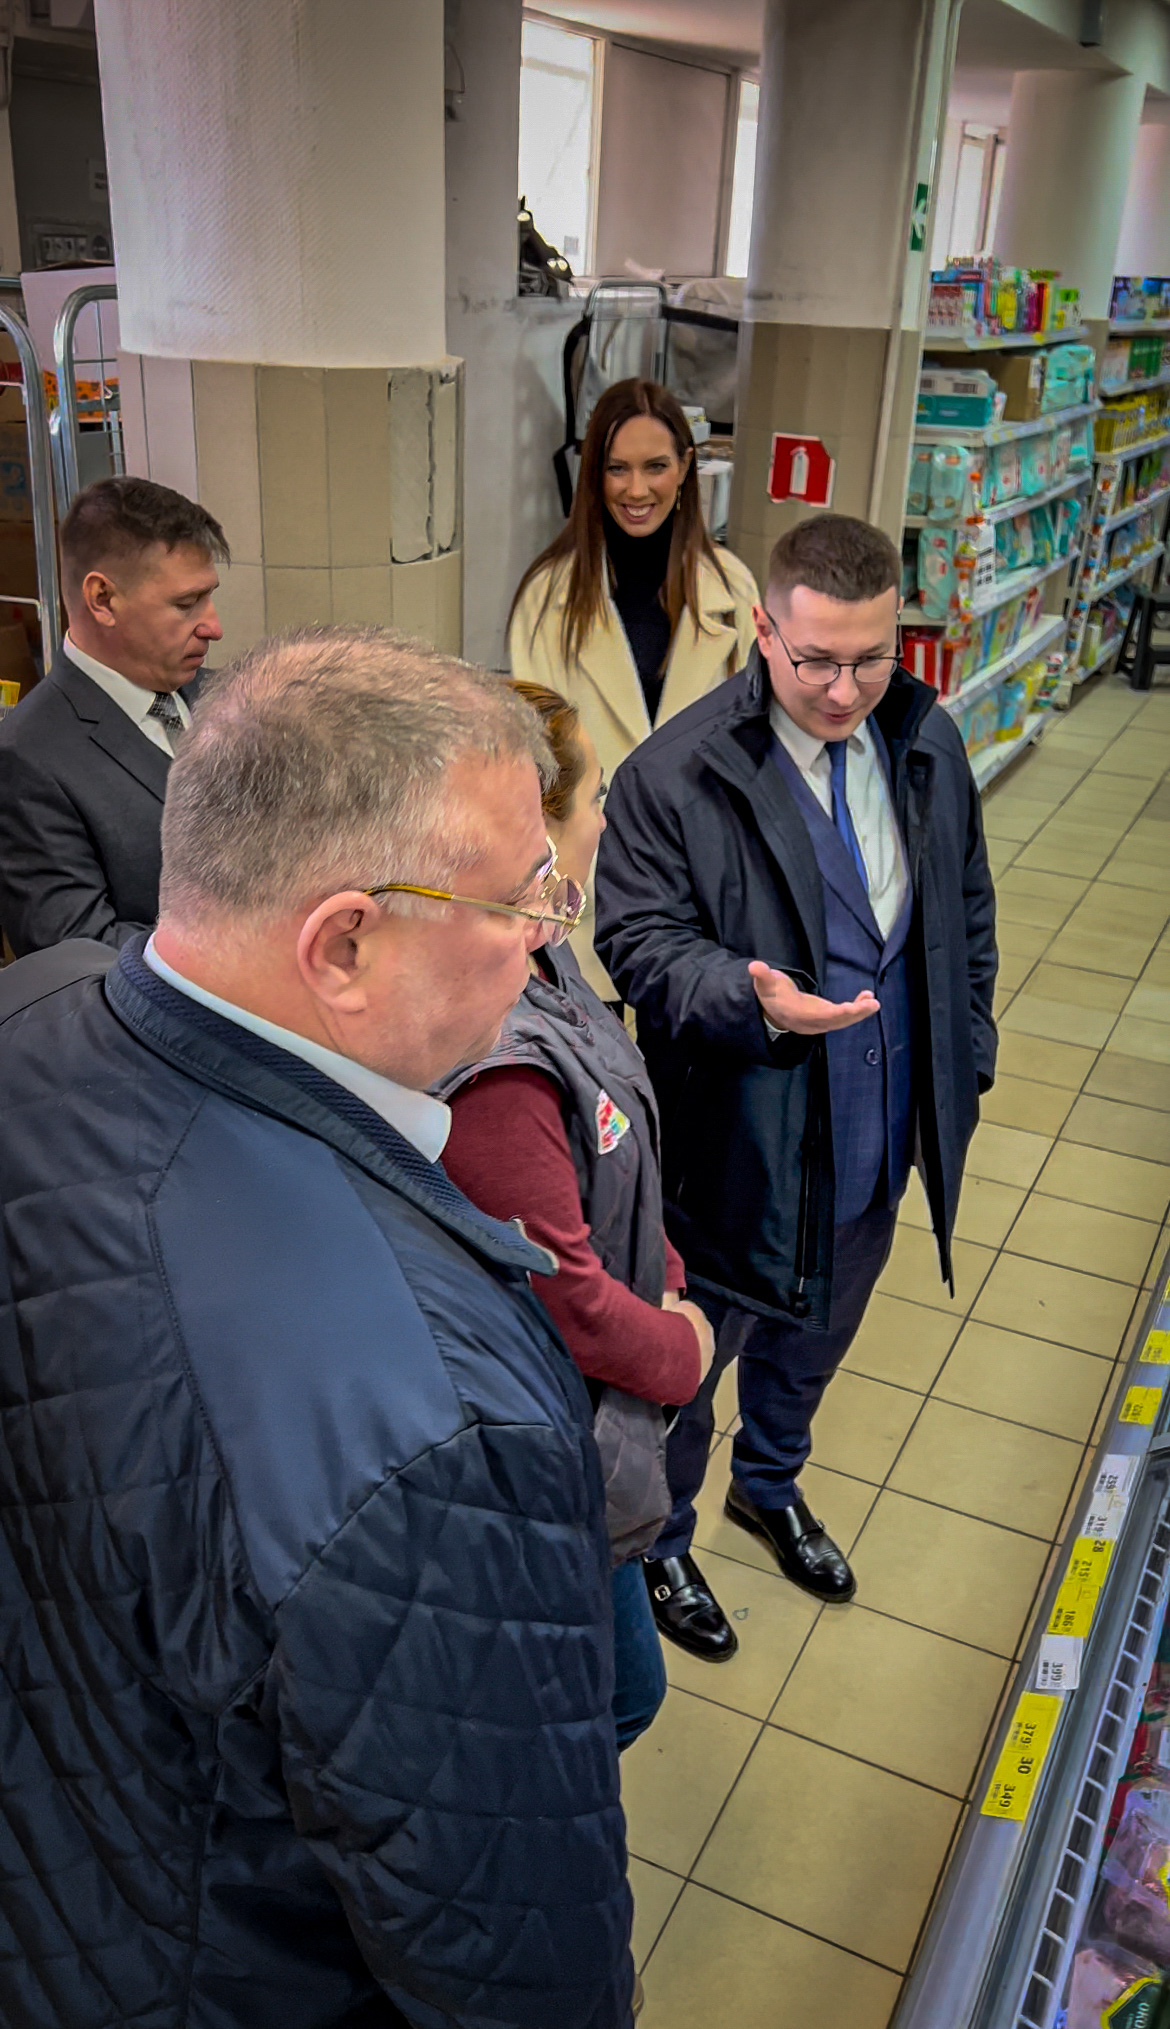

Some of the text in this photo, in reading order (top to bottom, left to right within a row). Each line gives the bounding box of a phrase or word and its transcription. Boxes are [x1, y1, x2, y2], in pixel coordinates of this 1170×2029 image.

[1021, 1722, 1037, 1745] 379
[1017, 1756, 1034, 1775] 30
[999, 1783, 1016, 1808] 349
